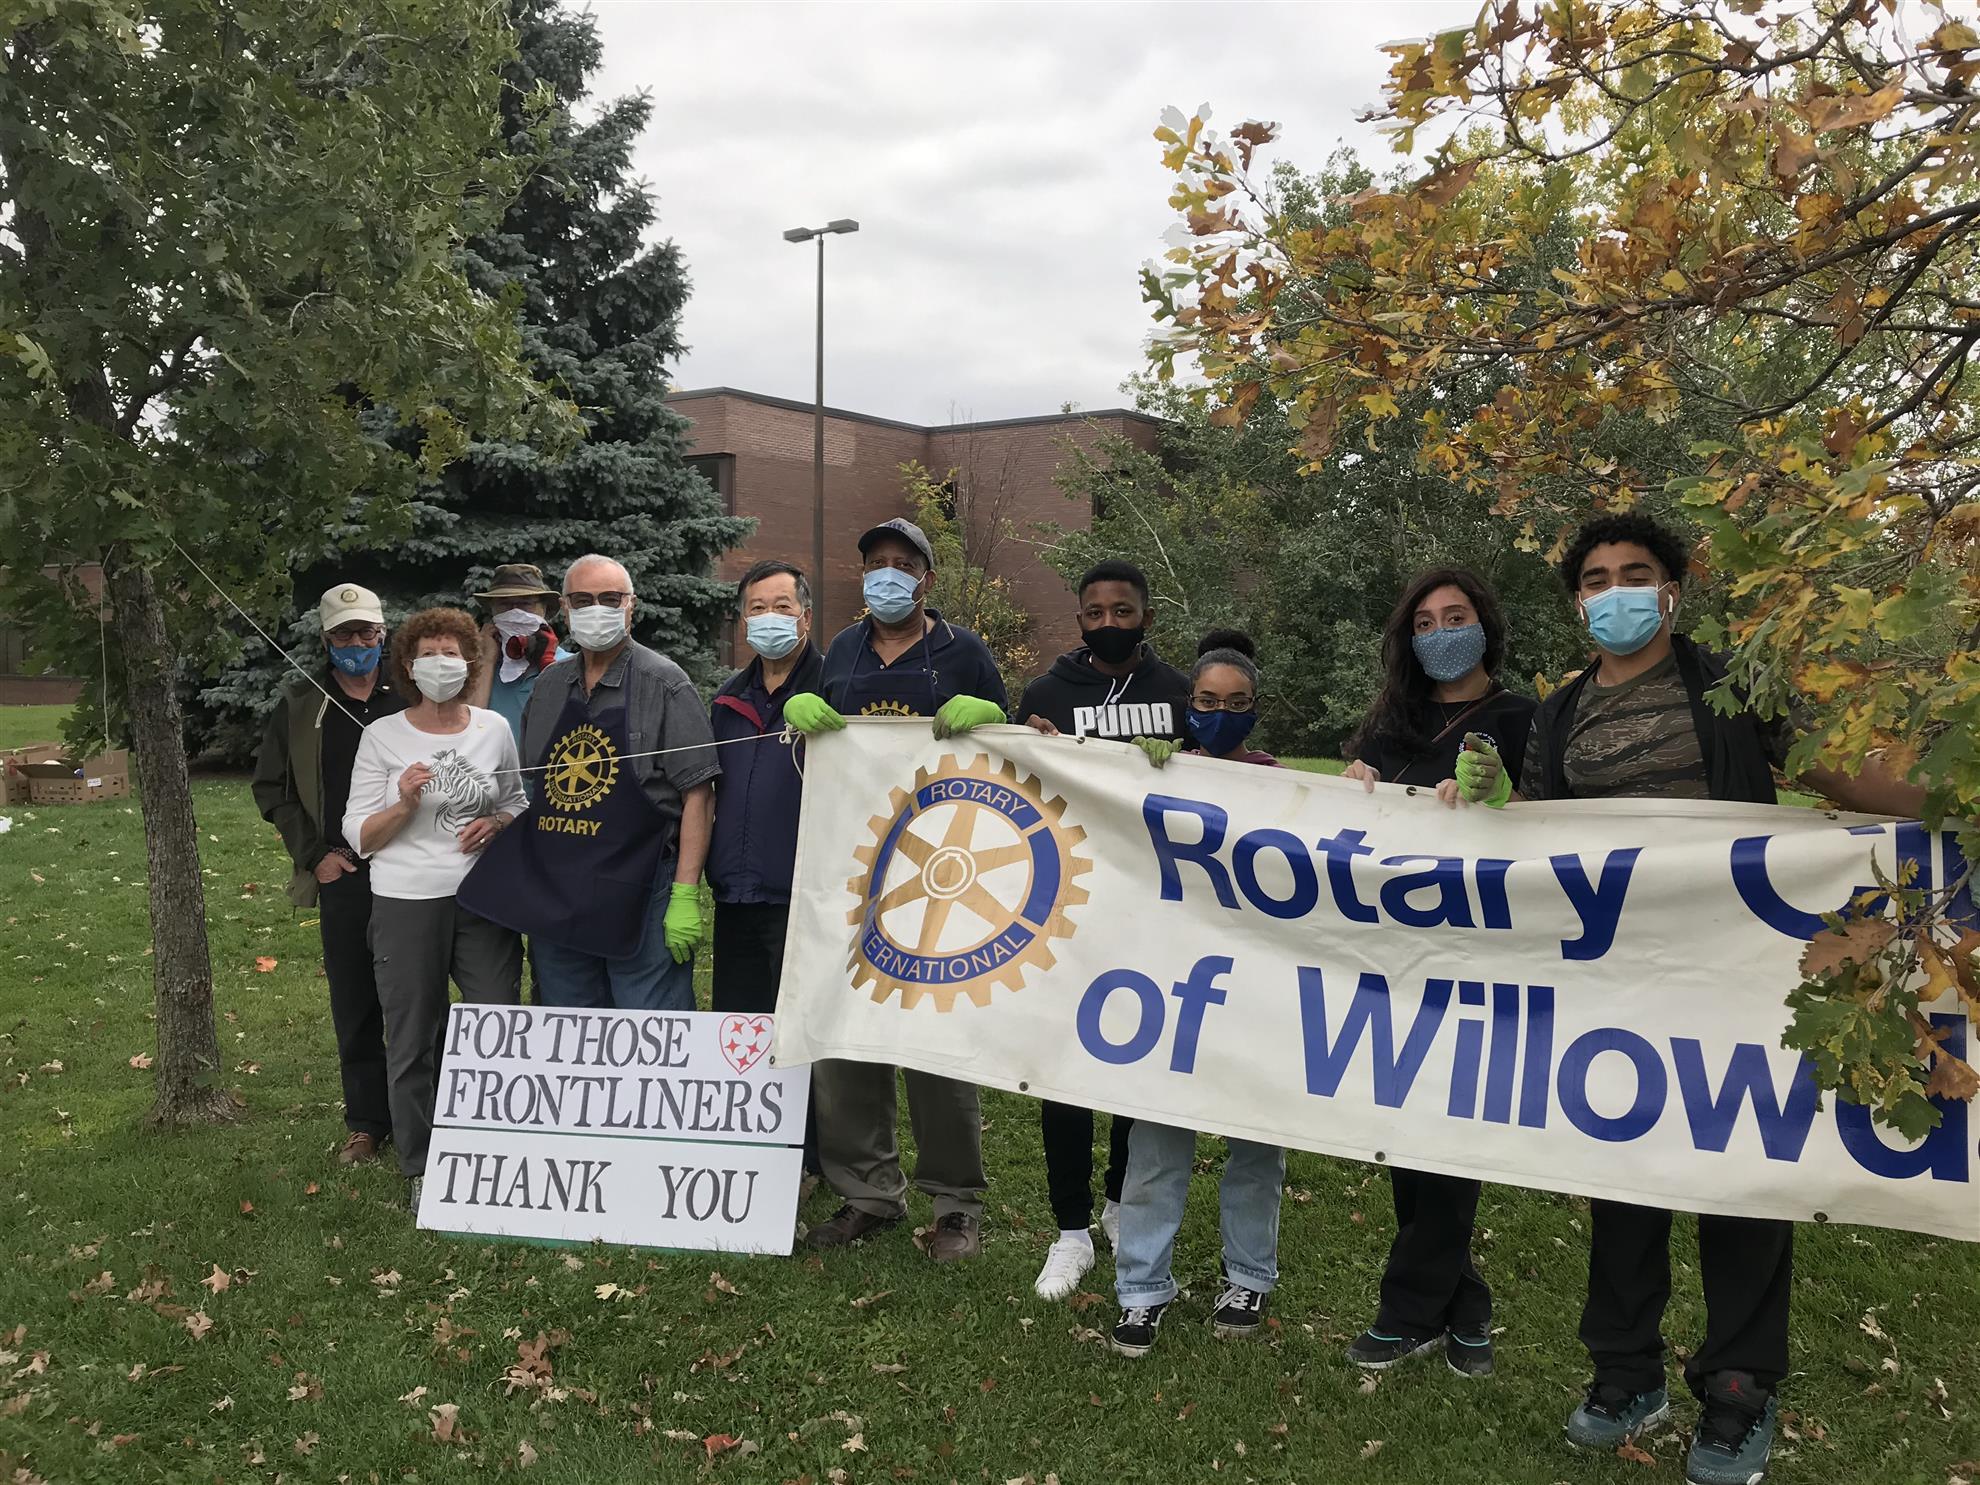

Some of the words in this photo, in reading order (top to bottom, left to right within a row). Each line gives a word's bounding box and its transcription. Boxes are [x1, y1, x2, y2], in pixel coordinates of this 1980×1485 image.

[572, 733, 598, 743] ROTARY
[1073, 703, 1174, 737] PUMA
[538, 816, 602, 836] ROTARY
[930, 780, 1028, 815] ROTARY
[1142, 793, 1645, 960] Rotary
[447, 1008, 533, 1060] FOR
[543, 1012, 691, 1068] THOSE
[1076, 955, 1234, 1074] of
[1296, 966, 1980, 1184] Willowd
[443, 1068, 783, 1134] FRONTLINERS
[437, 1151, 612, 1214] THANK
[658, 1165, 759, 1224] YOU
